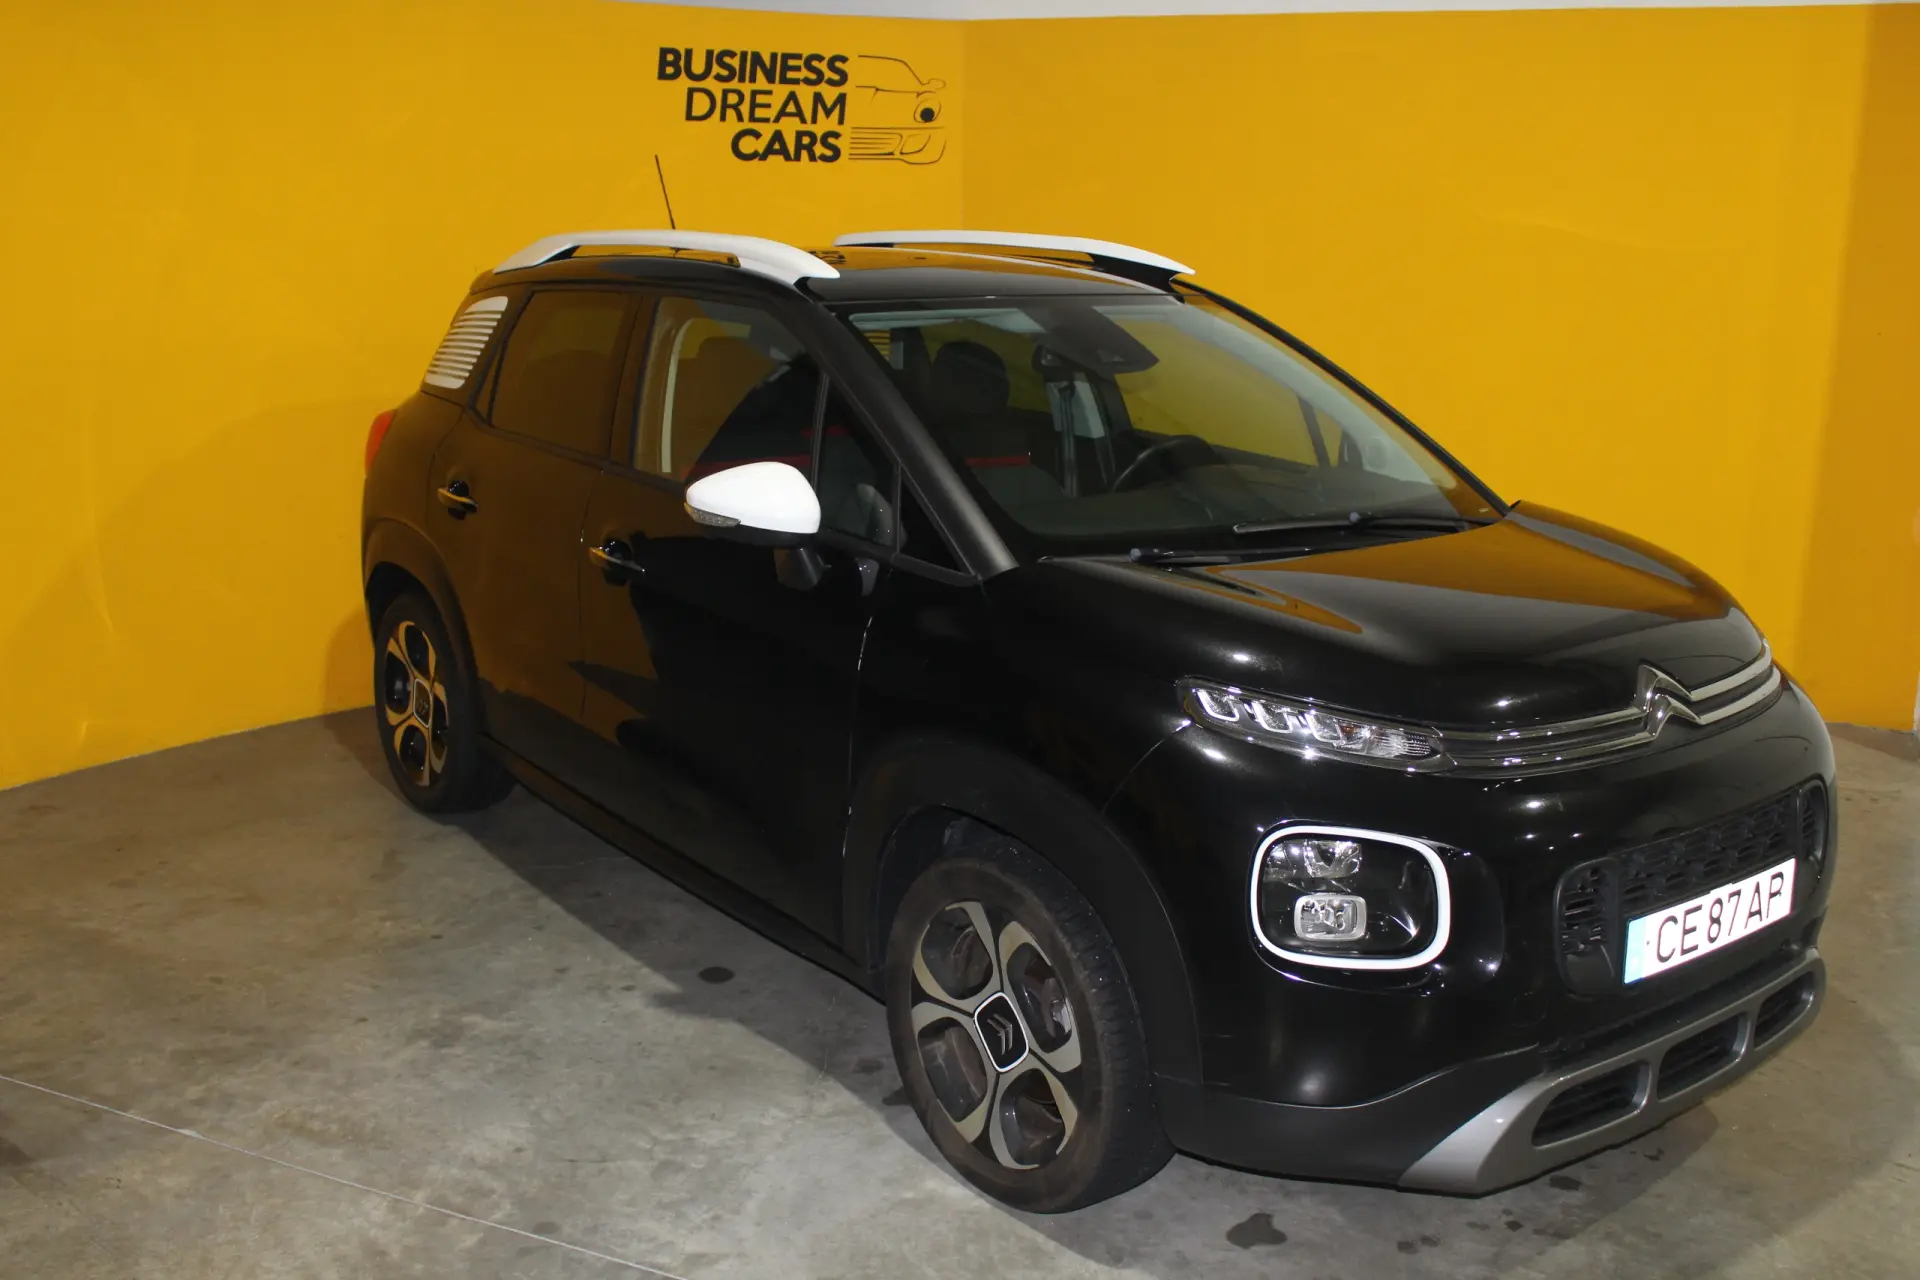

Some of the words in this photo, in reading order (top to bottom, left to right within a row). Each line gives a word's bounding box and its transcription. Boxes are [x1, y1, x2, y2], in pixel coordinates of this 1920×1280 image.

[657, 47, 849, 87] BUSINESS
[685, 87, 847, 125] DREAM
[731, 128, 842, 163] CARS
